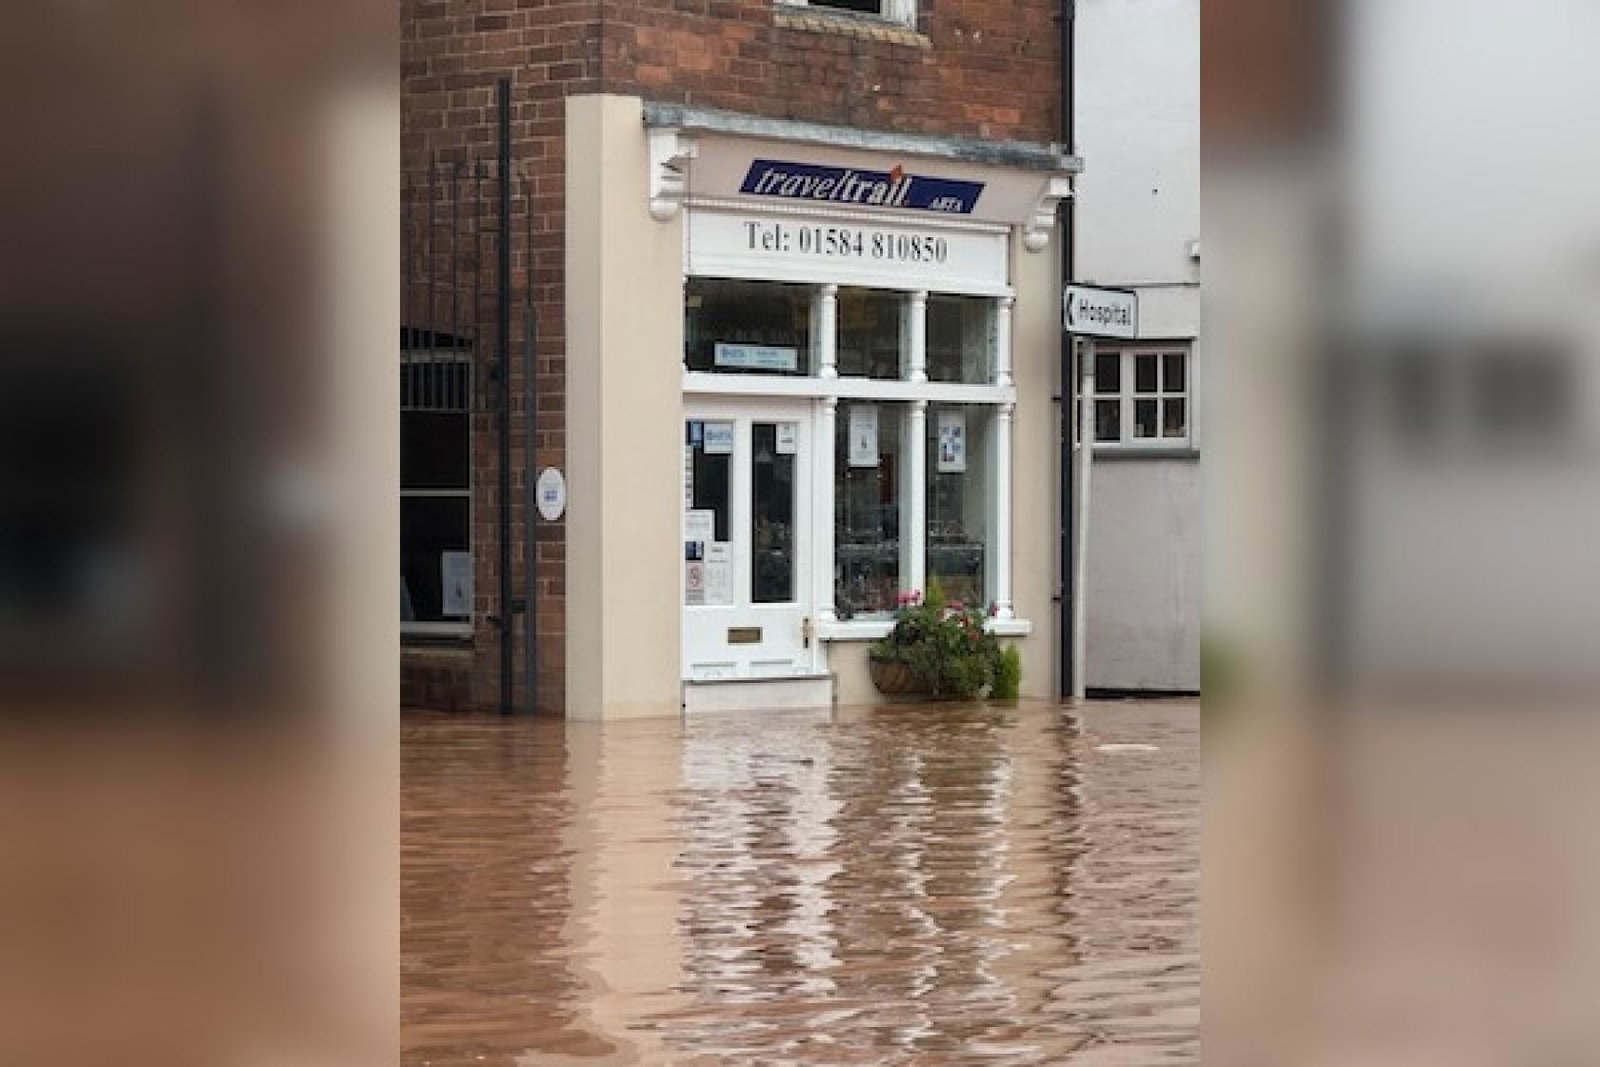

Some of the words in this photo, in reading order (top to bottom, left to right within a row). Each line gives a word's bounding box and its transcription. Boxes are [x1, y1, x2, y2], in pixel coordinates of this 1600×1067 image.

[744, 221, 790, 252] Tel:
[799, 227, 863, 257] 01584
[872, 231, 948, 264] 810850
[1080, 298, 1132, 326] Hospital
